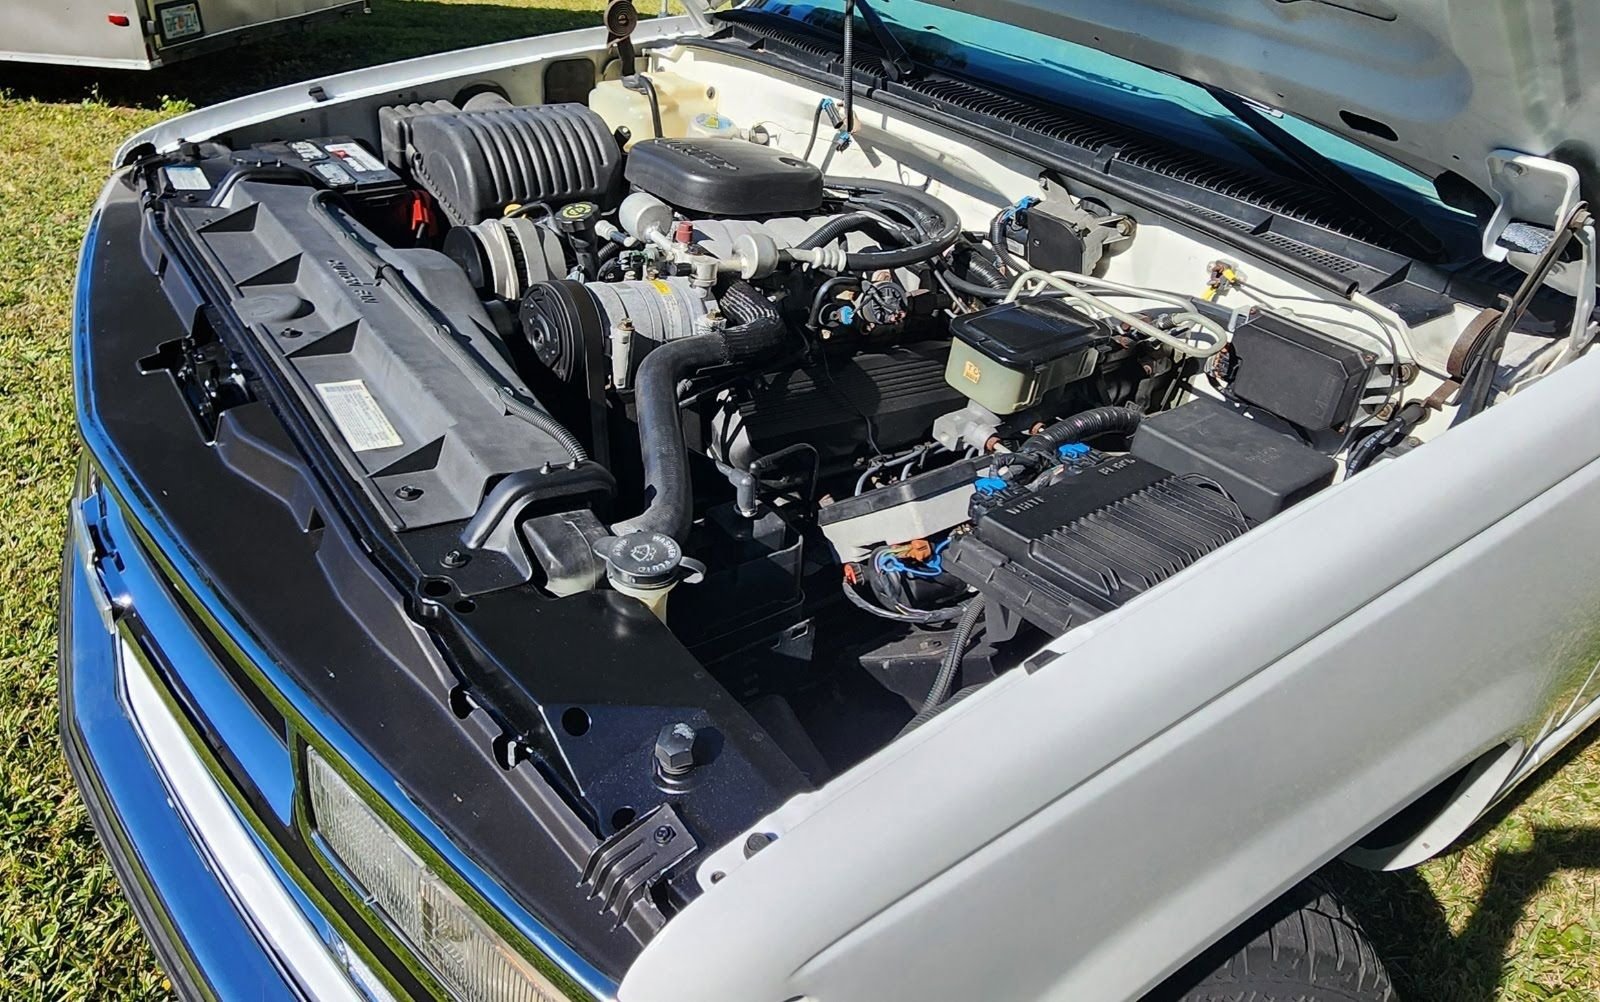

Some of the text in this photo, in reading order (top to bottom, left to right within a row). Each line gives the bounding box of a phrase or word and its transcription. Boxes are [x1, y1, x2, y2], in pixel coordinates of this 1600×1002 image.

[1004, 496, 1047, 515] WHITE
[651, 534, 677, 559] WASHER
[636, 559, 672, 573] FLUID
